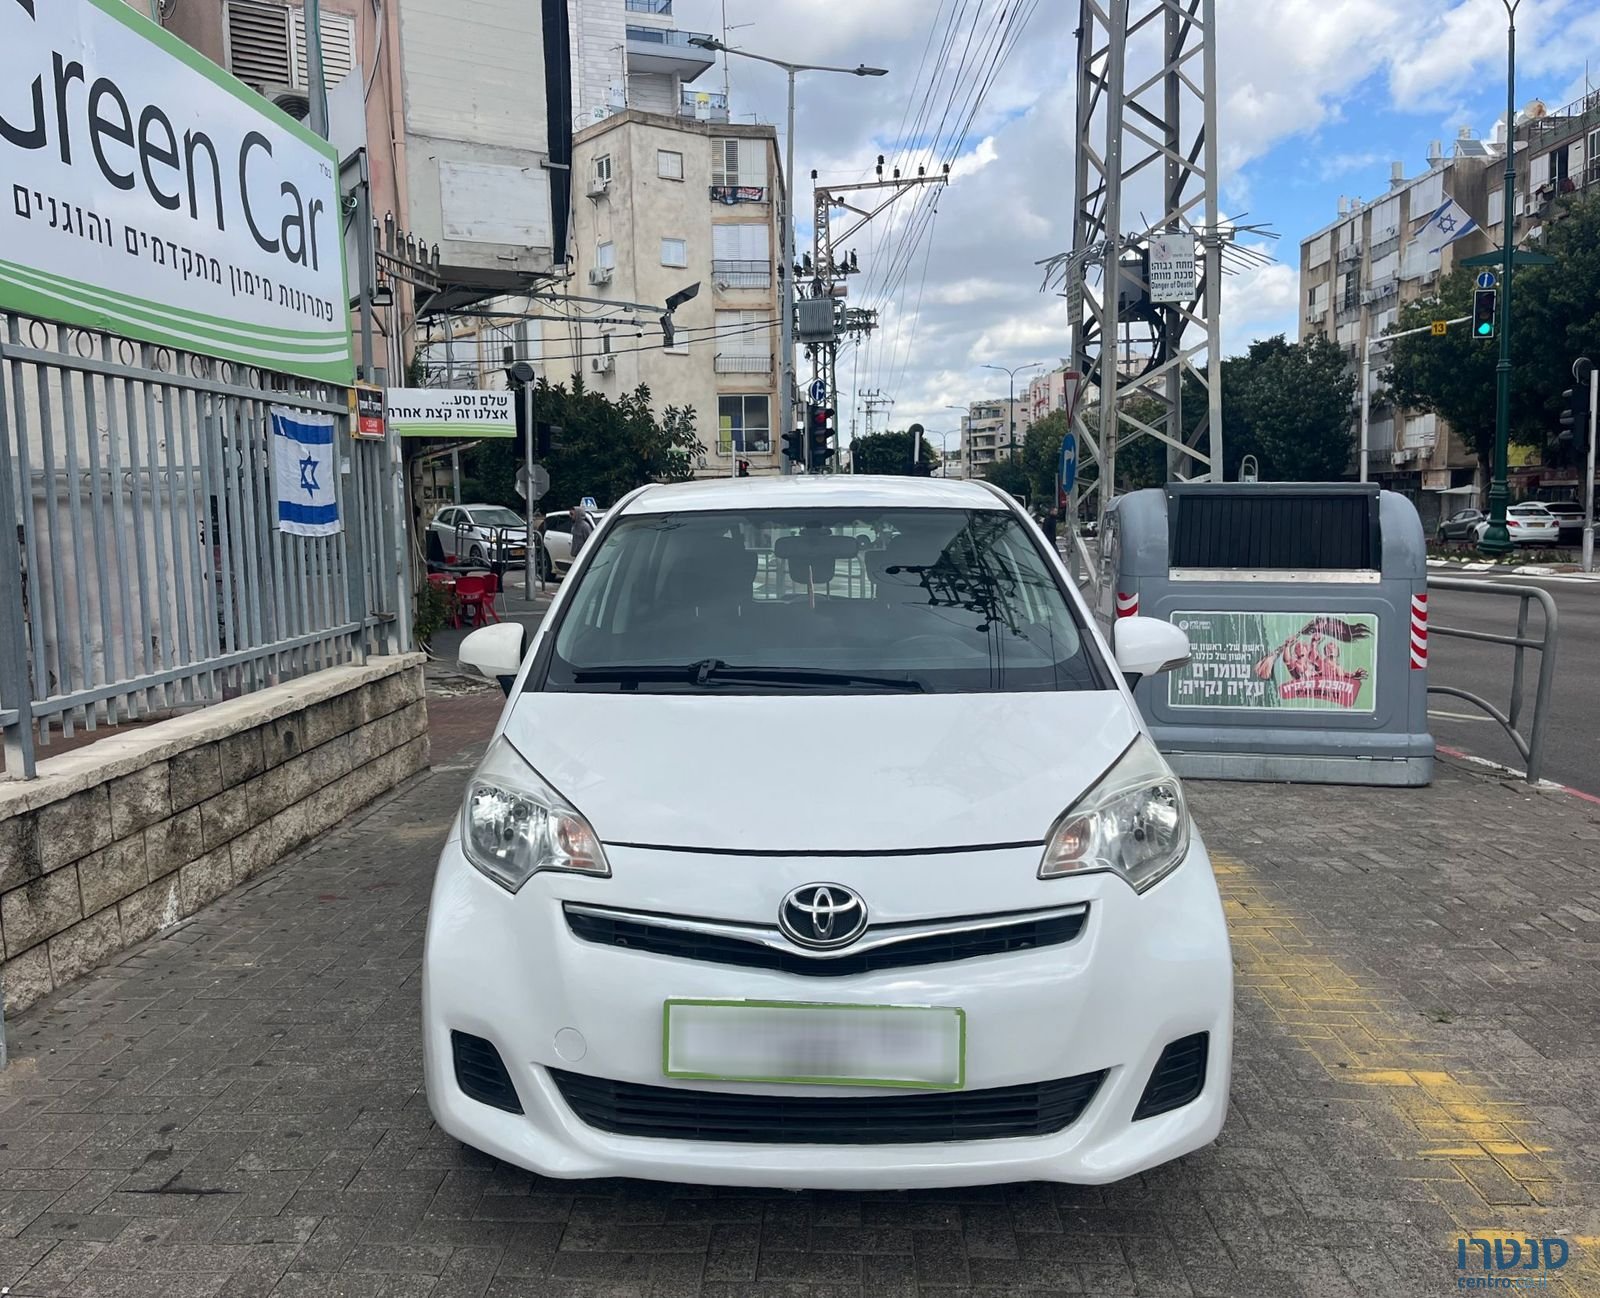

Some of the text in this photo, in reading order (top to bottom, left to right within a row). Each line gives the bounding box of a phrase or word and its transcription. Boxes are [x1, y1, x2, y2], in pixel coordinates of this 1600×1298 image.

[239, 130, 323, 272] Car
[13, 183, 333, 322] פתרונות מימון מתקדמים והוגנים
[1151, 281, 1169, 290] Danger
[1434, 323, 1444, 333] 13
[441, 395, 476, 406] וסע...
[480, 394, 508, 406] שלם
[388, 407, 508, 421] אצלנו זה קצת אחרת
[1215, 651, 1227, 660] של
[1192, 662, 1251, 679] שומרים
[1178, 678, 1265, 698] עליה נקייה!
